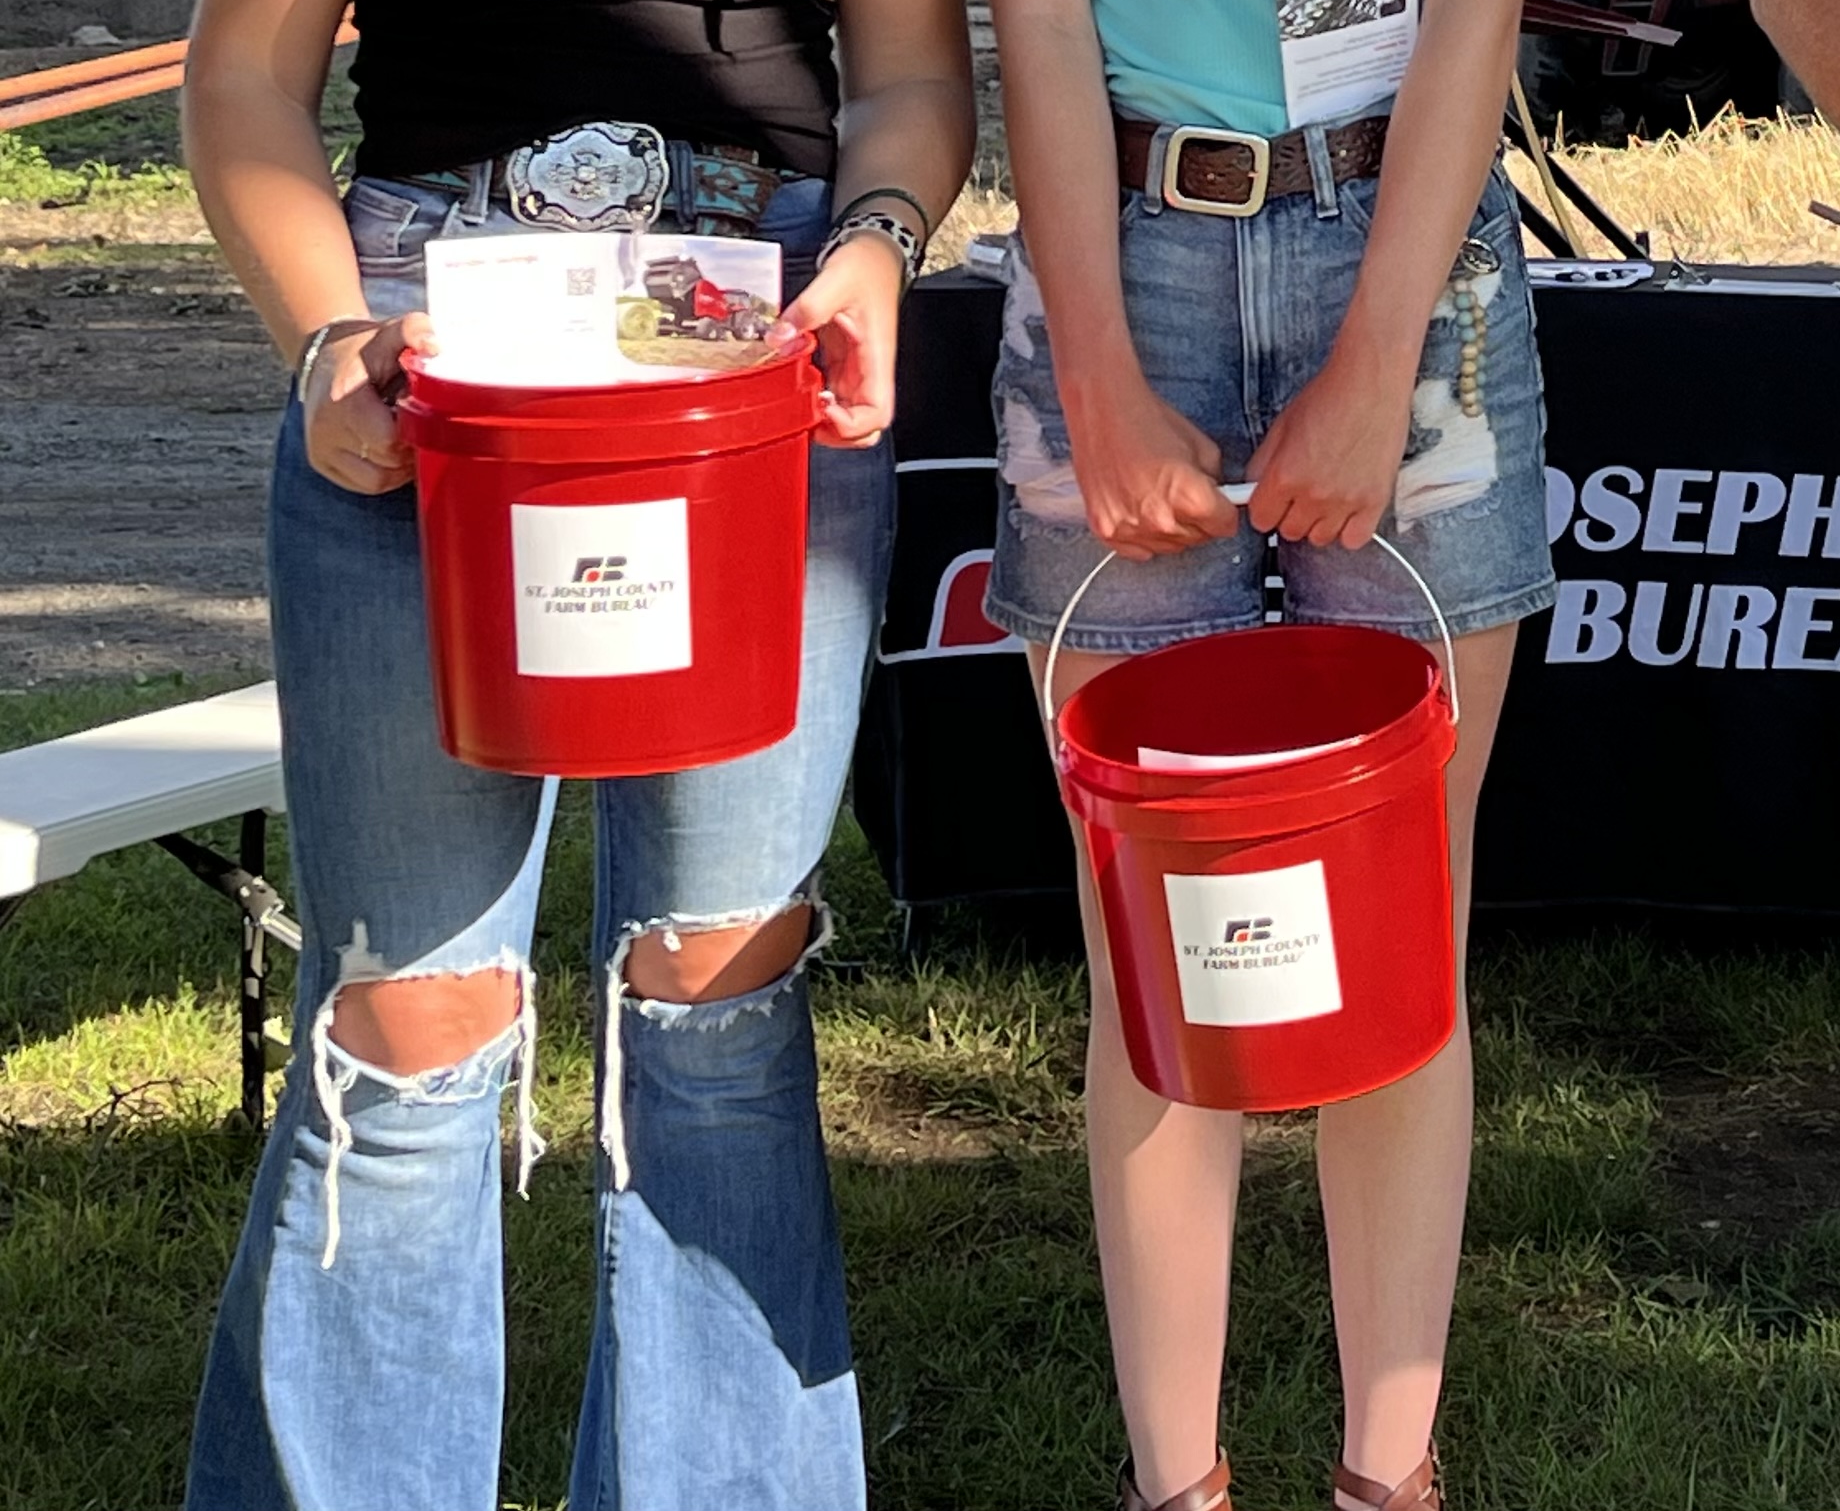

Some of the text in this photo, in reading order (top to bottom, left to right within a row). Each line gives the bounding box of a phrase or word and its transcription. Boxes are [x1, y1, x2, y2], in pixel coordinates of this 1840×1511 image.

[551, 586, 611, 598] JOSEPH
[616, 580, 675, 596] COUNTY
[544, 600, 586, 613] FARM
[1207, 945, 1261, 957] JOSEPH
[1264, 934, 1321, 953] COUNTY
[1203, 959, 1239, 970] FARM
